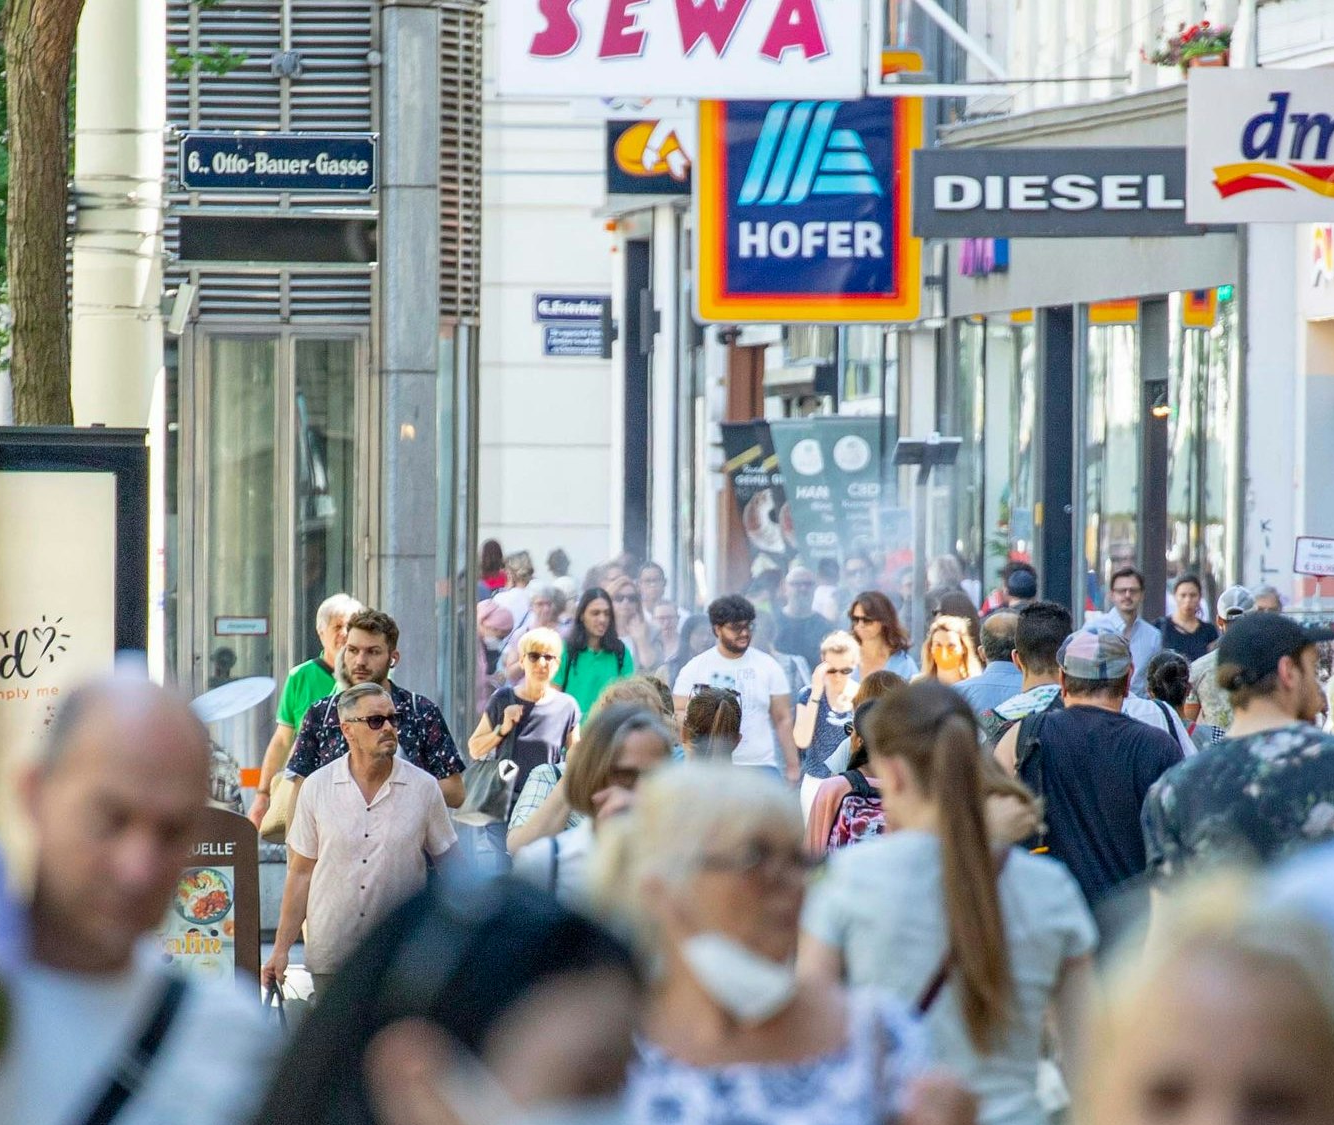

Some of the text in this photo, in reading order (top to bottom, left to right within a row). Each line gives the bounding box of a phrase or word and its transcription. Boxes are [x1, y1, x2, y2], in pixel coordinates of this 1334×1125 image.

[528, 0, 831, 62] SEWA
[212, 151, 369, 176] Otto-Bauer-Gasse
[933, 174, 1185, 211] DIESEL
[738, 220, 885, 259] HOFER
[36, 686, 59, 696] me
